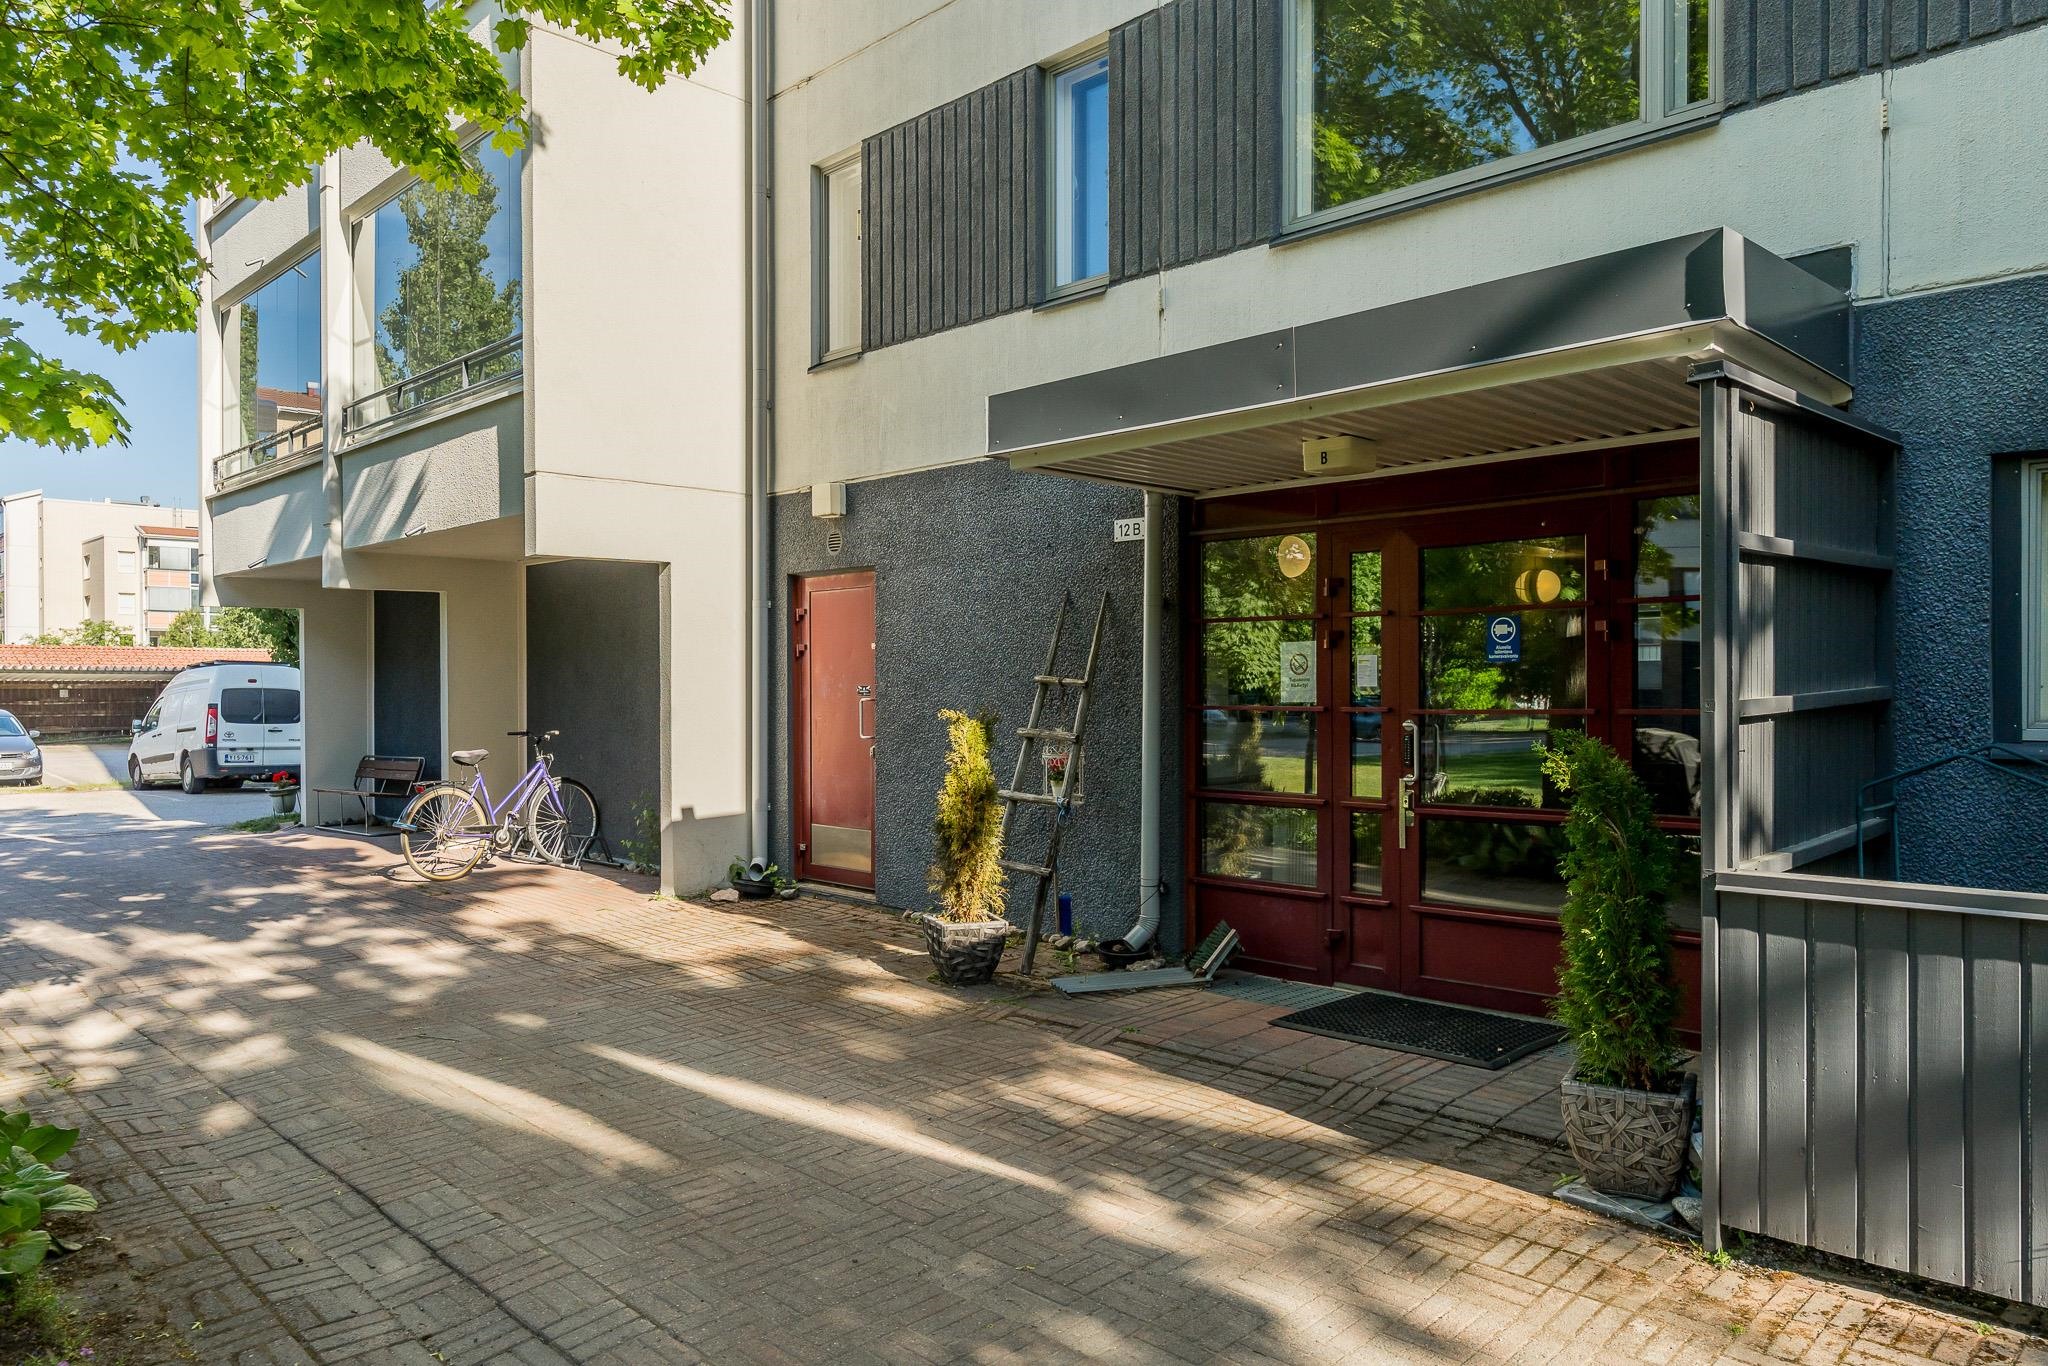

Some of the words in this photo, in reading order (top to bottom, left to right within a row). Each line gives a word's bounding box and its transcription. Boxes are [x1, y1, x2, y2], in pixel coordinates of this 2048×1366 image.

[1320, 451, 1328, 465] B
[1118, 523, 1131, 537] 12
[1133, 522, 1141, 536] B
